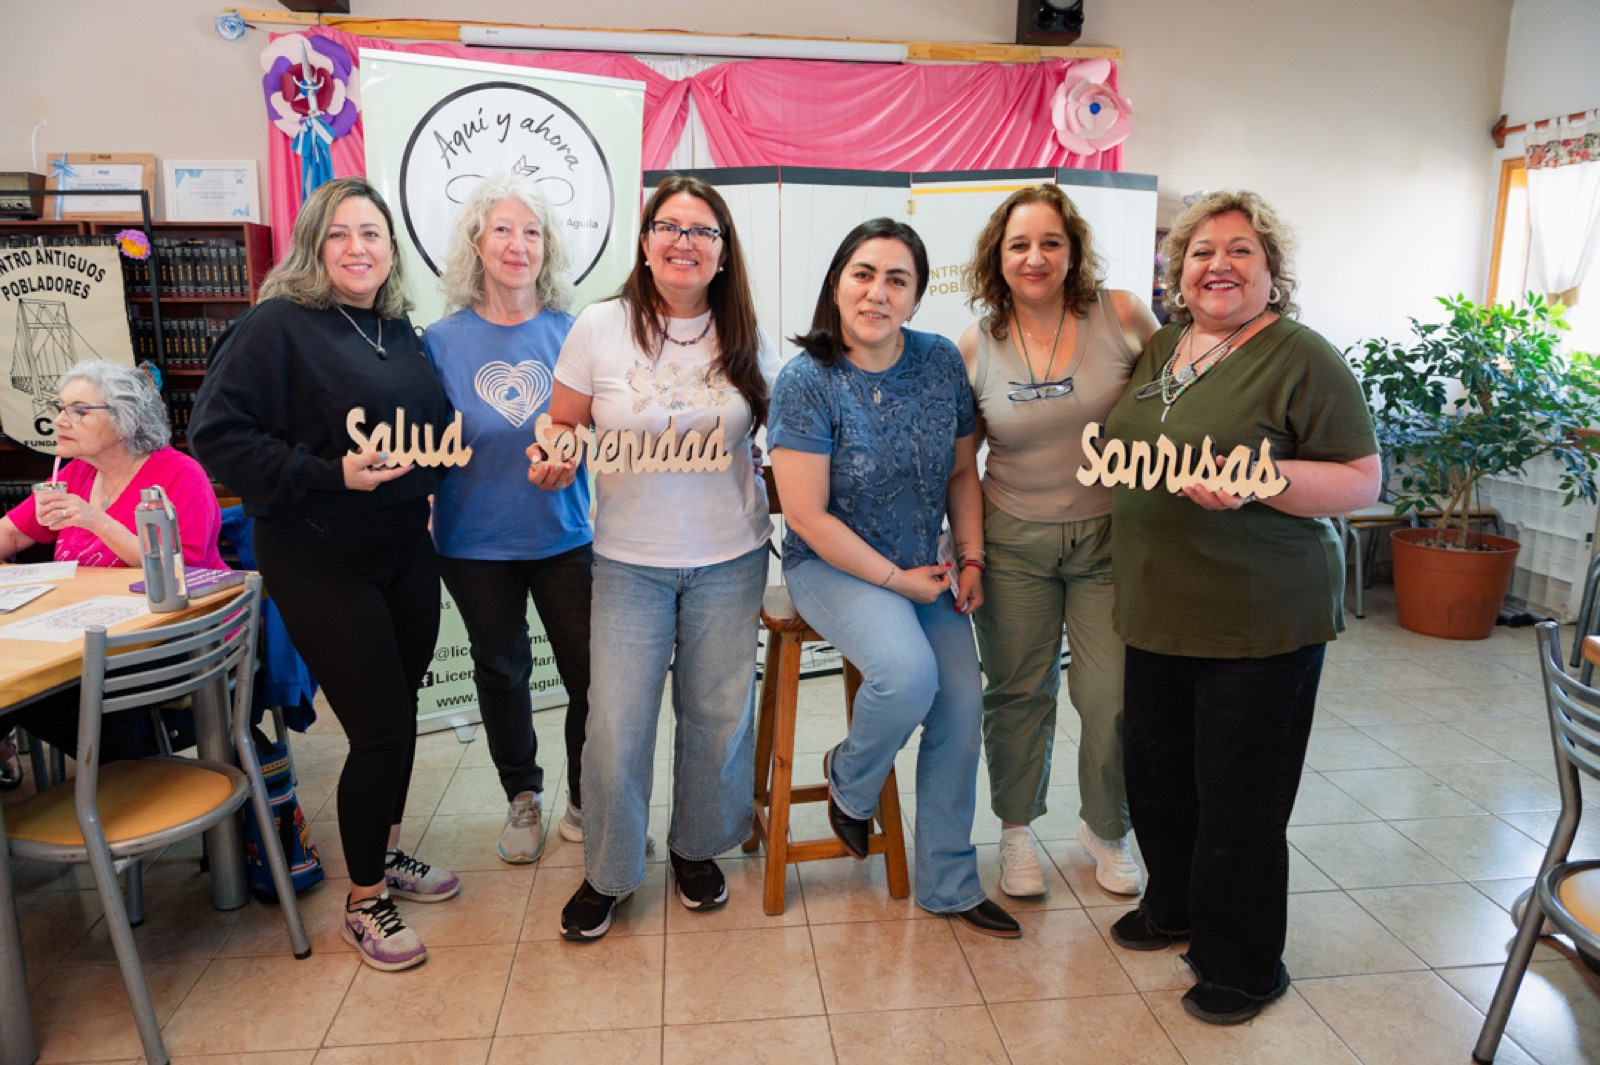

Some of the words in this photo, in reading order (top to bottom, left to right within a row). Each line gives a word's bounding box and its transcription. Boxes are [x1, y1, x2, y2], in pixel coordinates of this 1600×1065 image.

[433, 107, 490, 170] Aquí
[496, 112, 512, 143] y
[519, 113, 580, 171] ahora
[1, 275, 91, 302] POBLADORES
[36, 249, 106, 283] ANTIGUOS
[346, 406, 473, 468] Salud
[534, 412, 733, 475] Serenidad
[1076, 421, 1291, 500] Sonrisas
